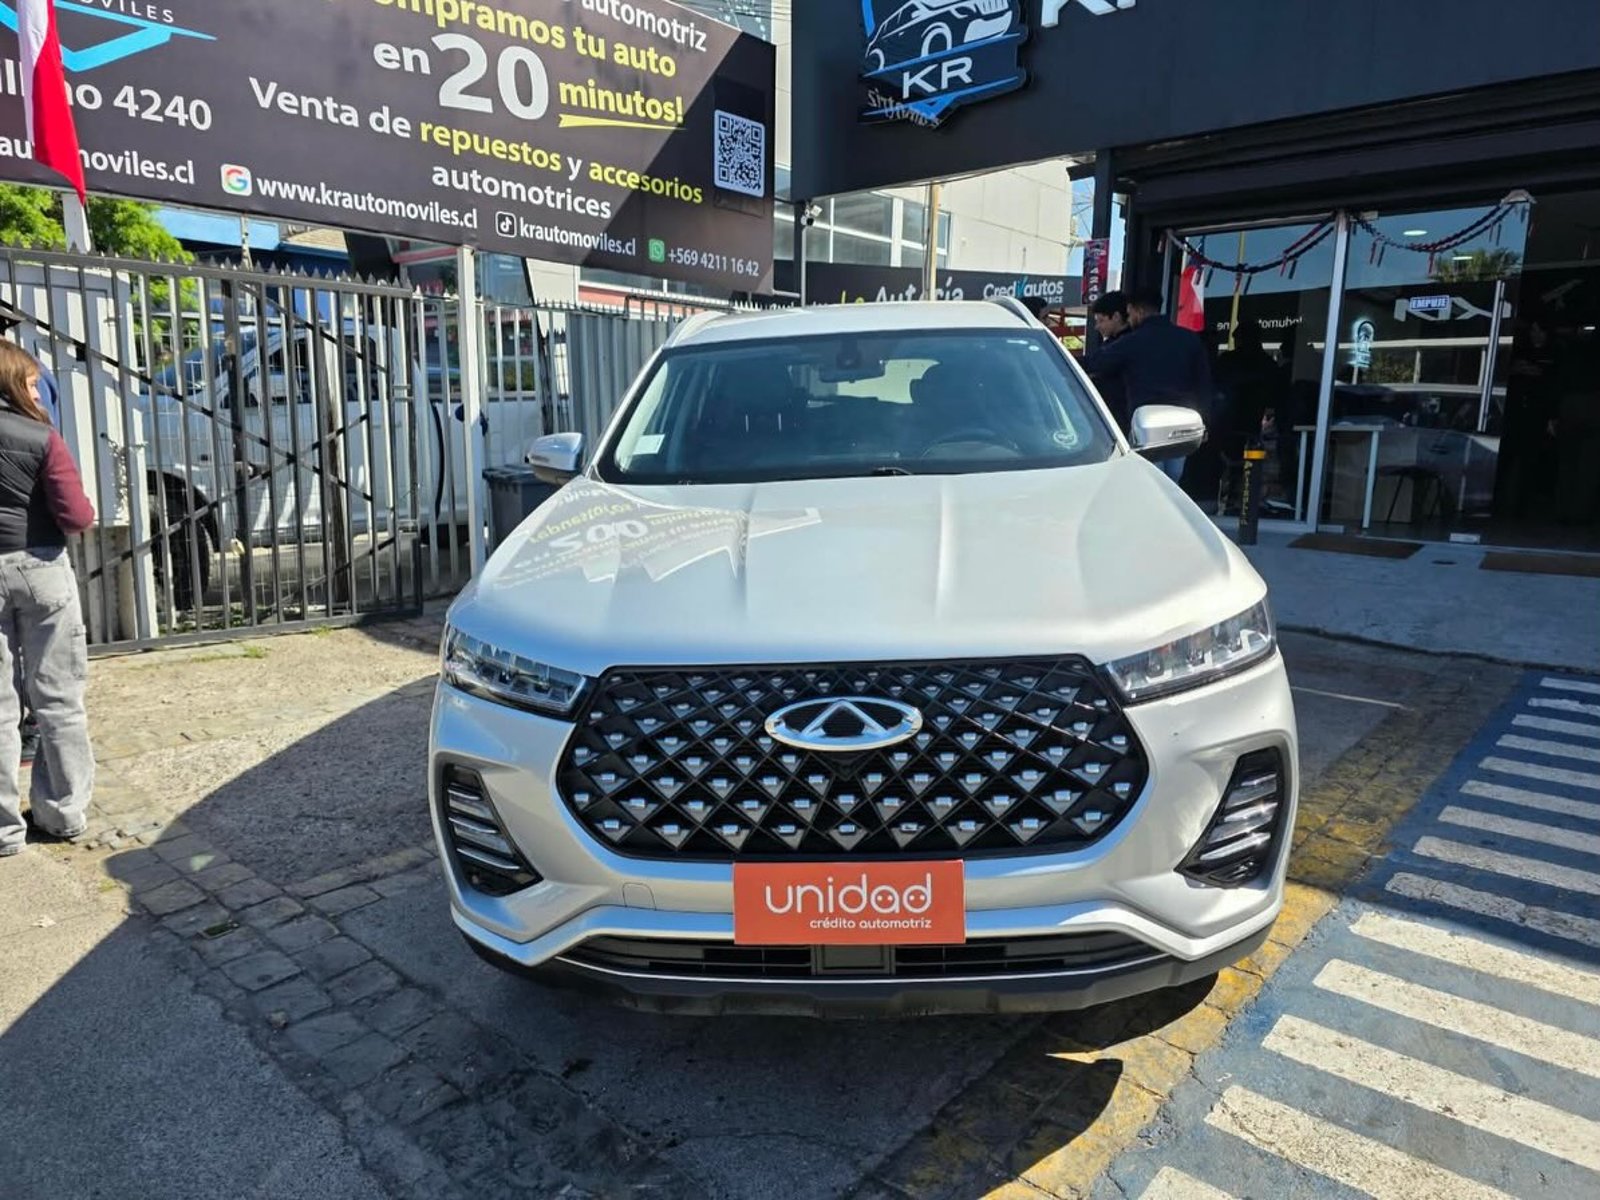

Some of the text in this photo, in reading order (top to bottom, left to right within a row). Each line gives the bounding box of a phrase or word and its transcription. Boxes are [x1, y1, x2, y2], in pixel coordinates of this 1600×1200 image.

[572, 27, 605, 60] tu
[613, 42, 676, 77] auto
[373, 32, 684, 124] en 20 minutos!
[902, 56, 973, 99] KR
[113, 85, 213, 131] 4240
[249, 76, 704, 204] Venta de repuestos y accesorios
[256, 177, 478, 229] www.krautomoviles.cl
[431, 165, 612, 219] automotrices
[520, 217, 636, 256] krautomoviles.cl
[668, 247, 699, 267] +569
[700, 252, 728, 272] 4211
[765, 873, 932, 913] unidad
[809, 917, 932, 930] crédito automotriz
